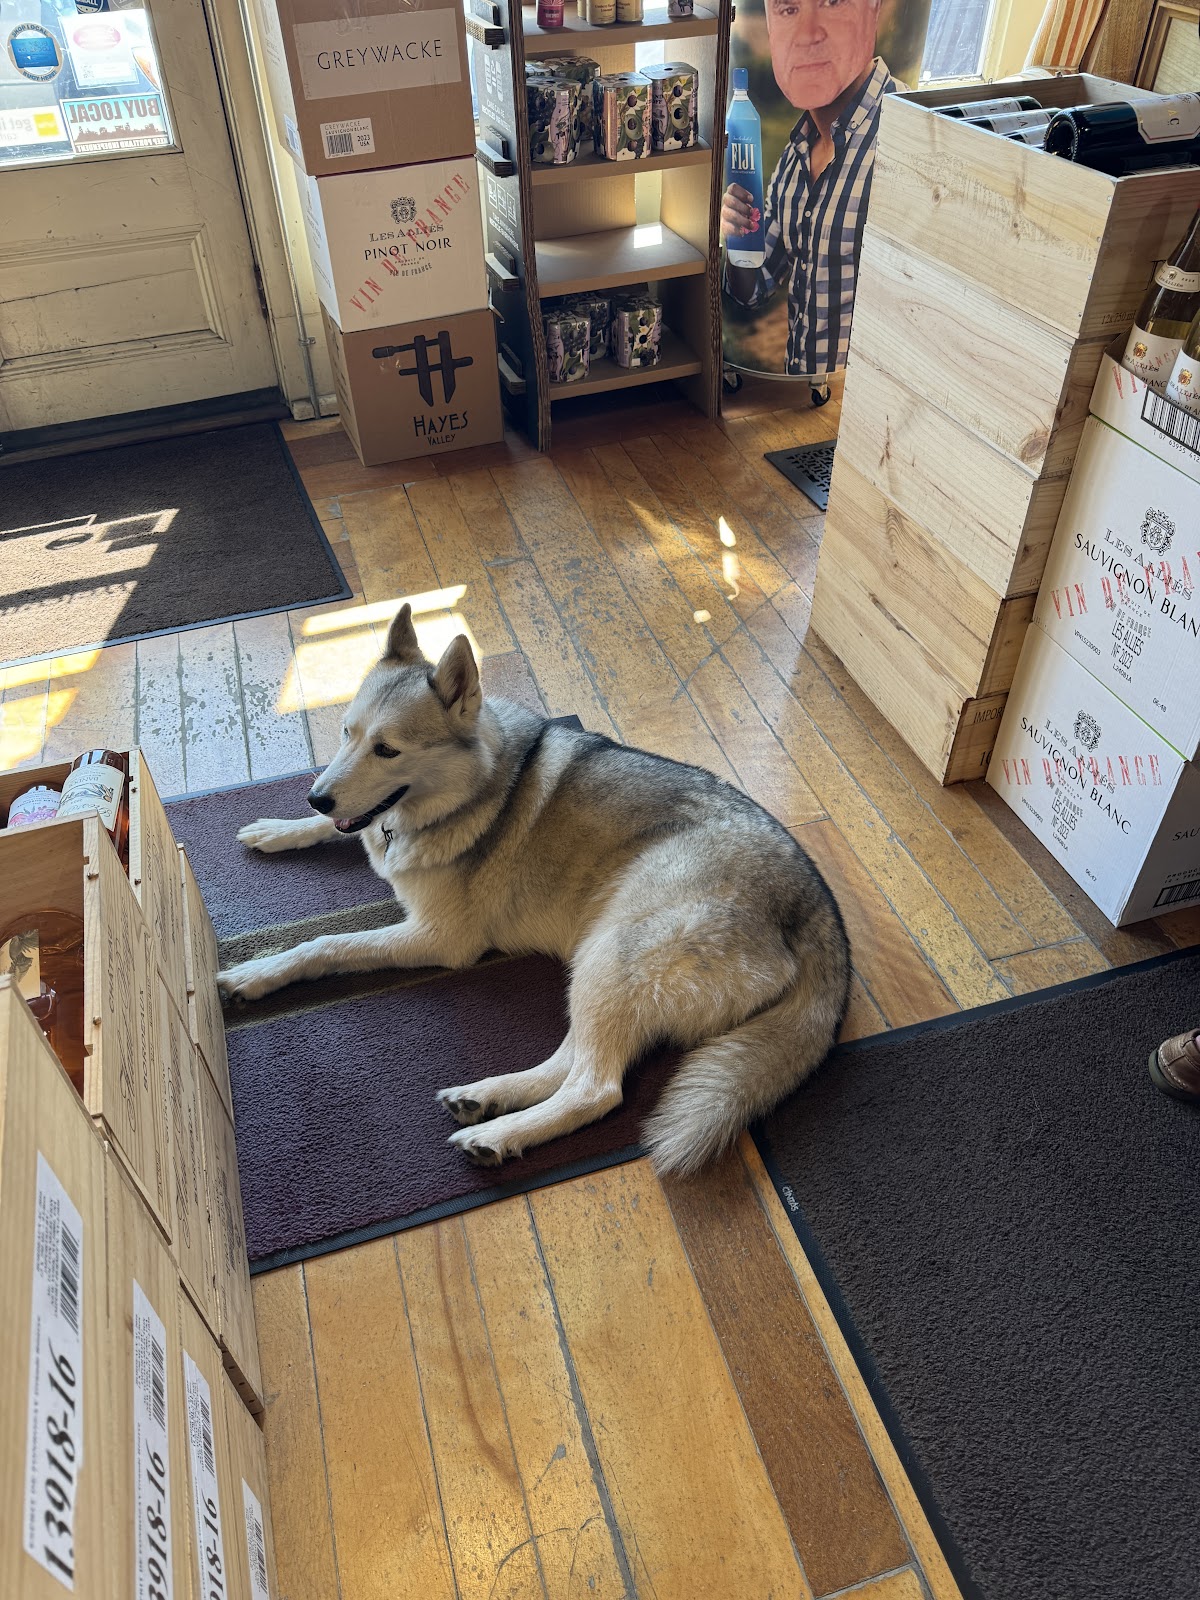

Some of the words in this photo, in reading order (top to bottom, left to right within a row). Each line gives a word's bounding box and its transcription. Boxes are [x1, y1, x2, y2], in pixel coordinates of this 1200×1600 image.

[317, 39, 443, 70] GREYWACKE
[325, 121, 361, 131] GREYWACKE
[357, 134, 370, 142] 2023
[731, 142, 755, 171] FIJI
[349, 277, 384, 313] VIN
[406, 173, 471, 244] FRANCE
[364, 243, 408, 260] PINOT
[415, 237, 452, 253] NOIR
[369, 231, 395, 242] LES
[413, 410, 469, 437] HAYES
[427, 433, 456, 446] VALLEY
[1169, 440, 1186, 454] 63955
[1104, 527, 1133, 558] LES
[1074, 533, 1157, 605] SAUVIGNON
[1050, 582, 1089, 620] VIN
[1111, 619, 1125, 641] LES
[1118, 648, 1134, 670] 2023
[1044, 718, 1068, 747] LES
[1000, 758, 1032, 786] VIN
[1076, 754, 1162, 786] FRANCE
[1020, 716, 1087, 791] SAUVIGNON
[1090, 787, 1132, 835] BLANC
[1051, 796, 1063, 815] LES
[107, 924, 115, 1014] CHÂTEAU
[139, 981, 149, 1094] BORDEAUX
